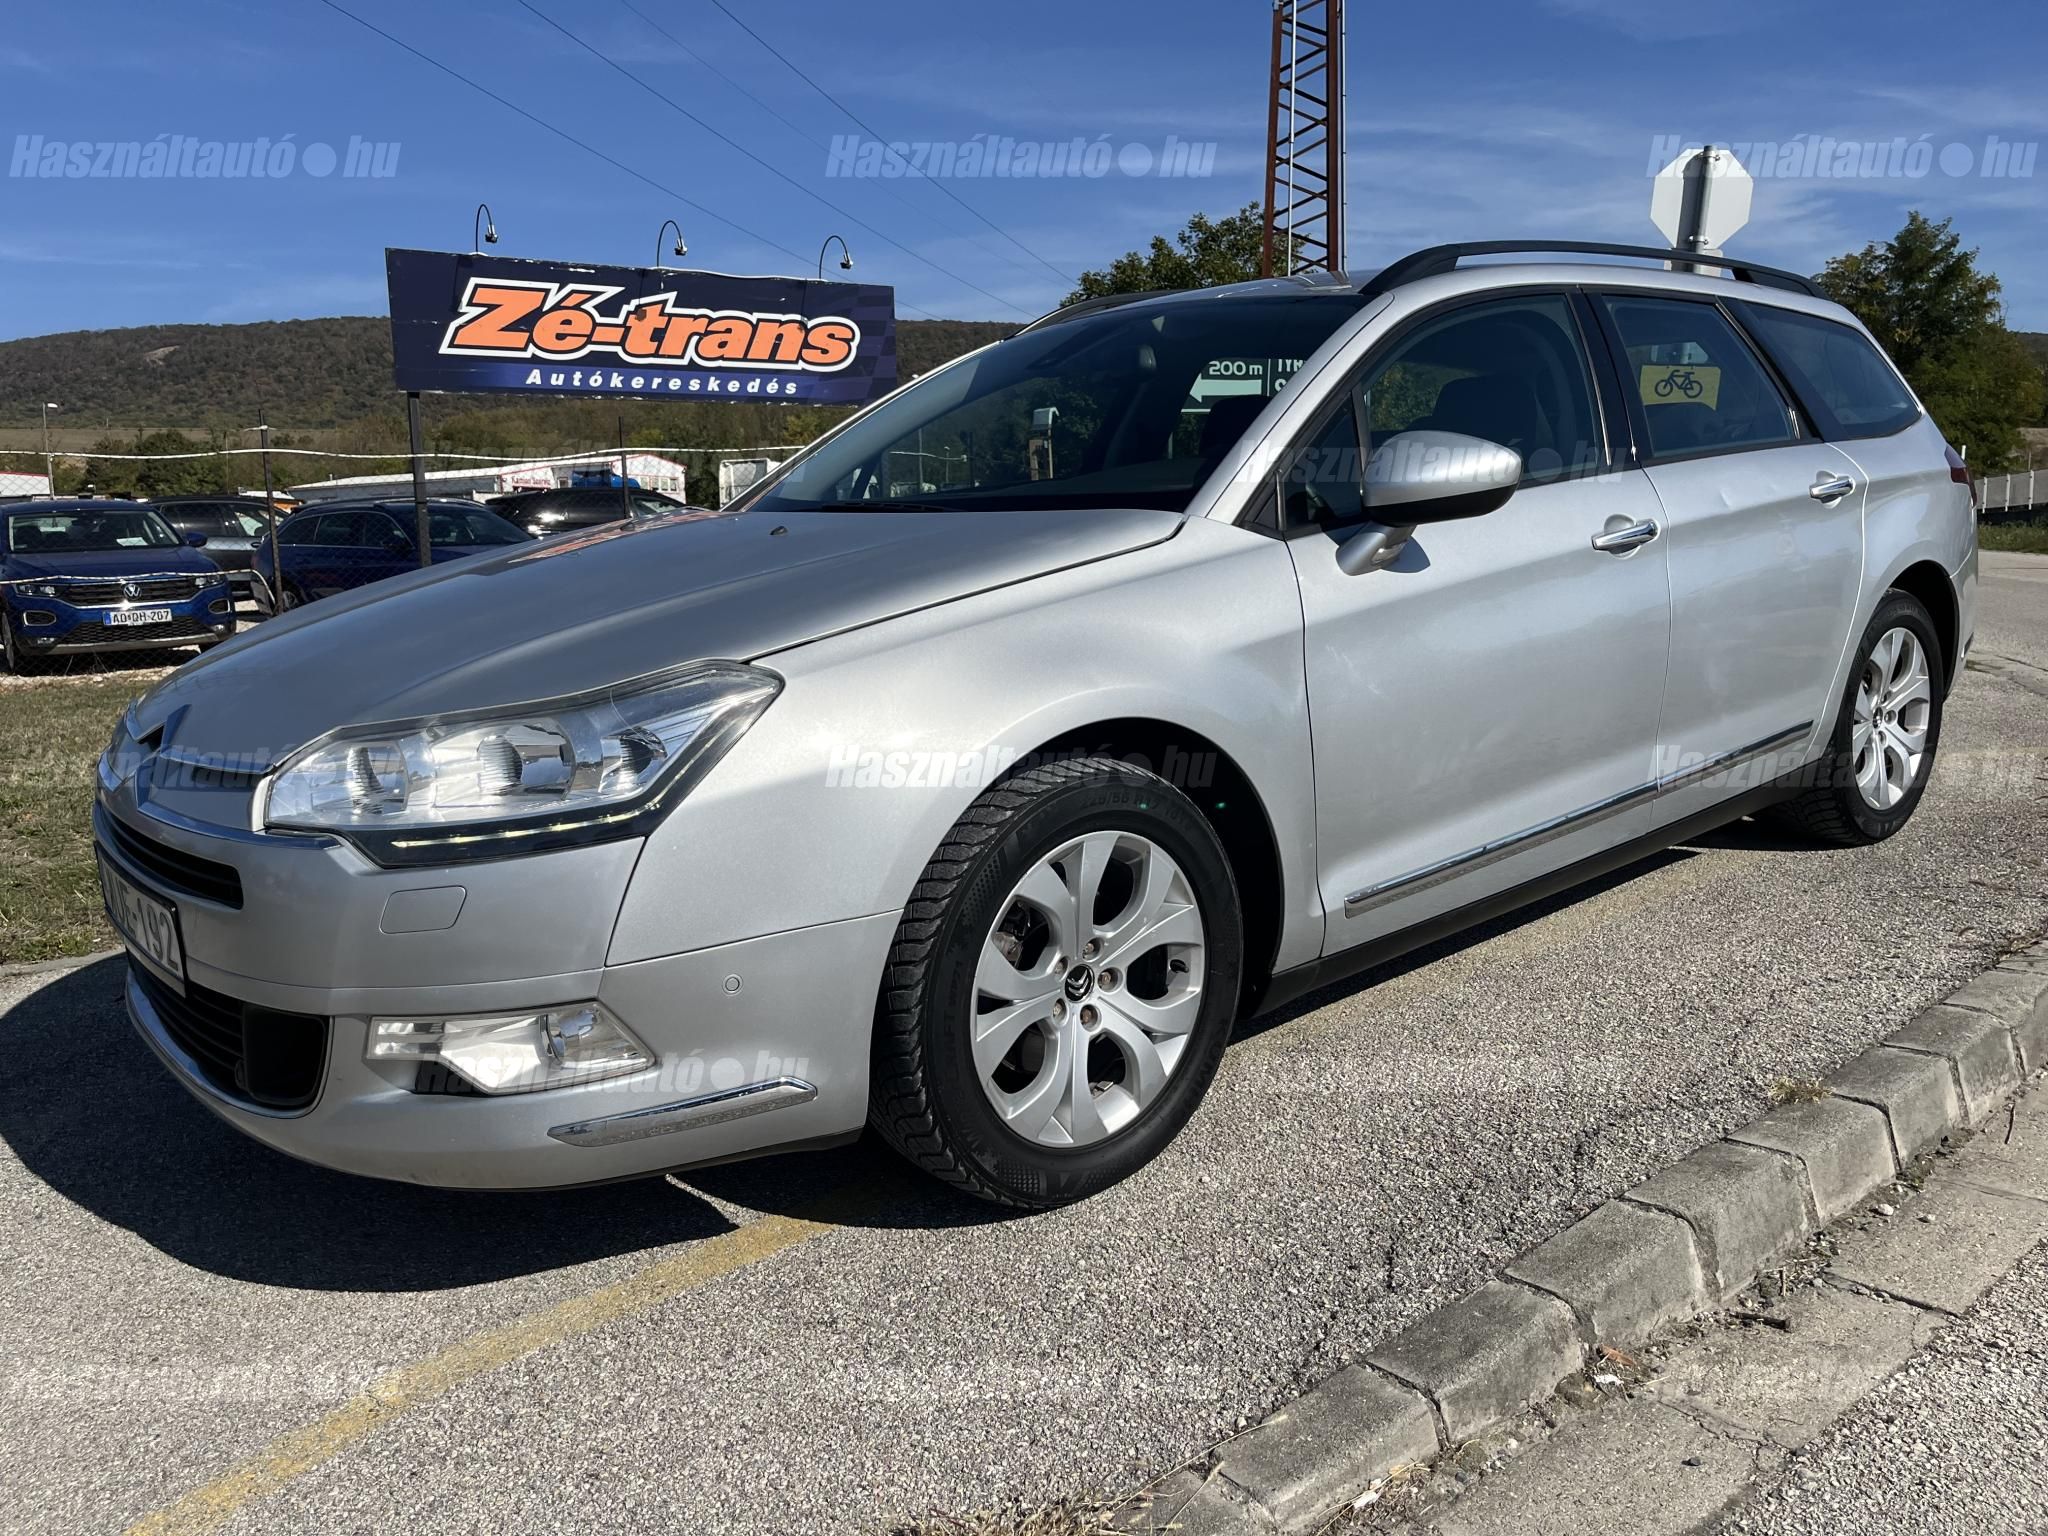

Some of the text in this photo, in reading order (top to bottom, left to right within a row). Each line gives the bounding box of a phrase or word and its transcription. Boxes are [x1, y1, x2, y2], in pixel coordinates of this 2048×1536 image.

[445, 280, 858, 369] Zé-trans
[525, 367, 797, 394] Autókereskedés
[1208, 360, 1263, 376] 200 m
